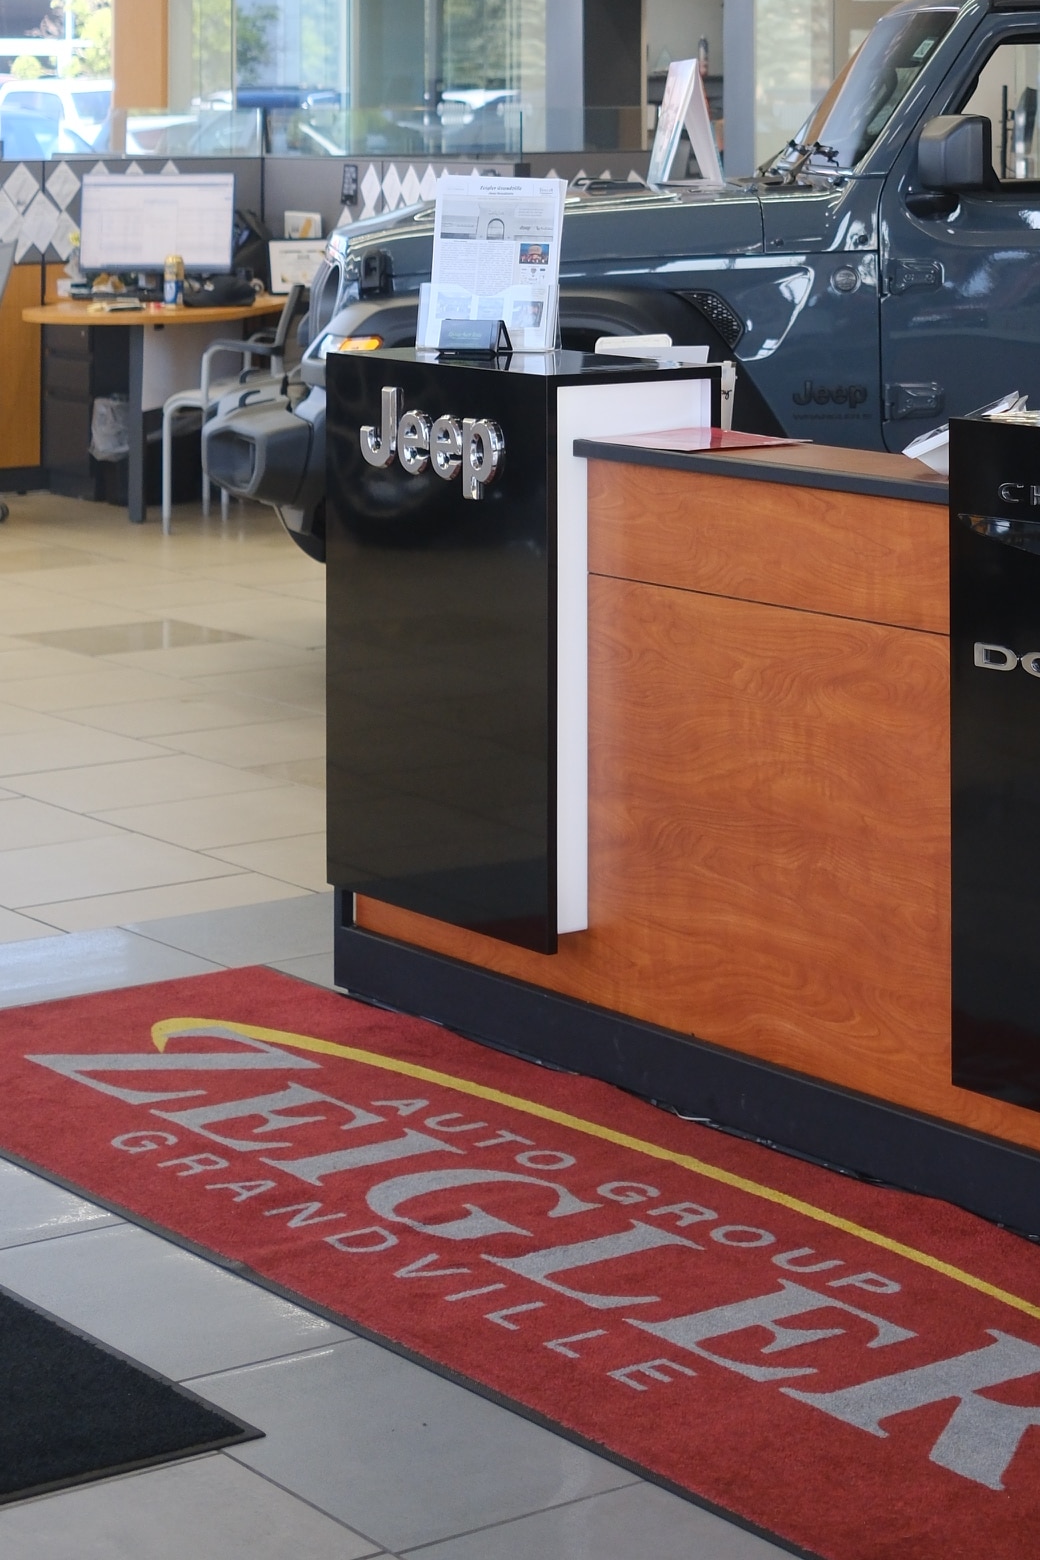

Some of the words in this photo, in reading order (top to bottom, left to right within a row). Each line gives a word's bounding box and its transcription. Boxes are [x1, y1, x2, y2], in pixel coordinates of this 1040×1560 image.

[360, 386, 506, 501] Jeep
[792, 380, 868, 408] Jeep
[110, 1129, 698, 1391] GRANDVILLE
[371, 1097, 576, 1171] AUTO
[595, 1180, 902, 1295] GROUP
